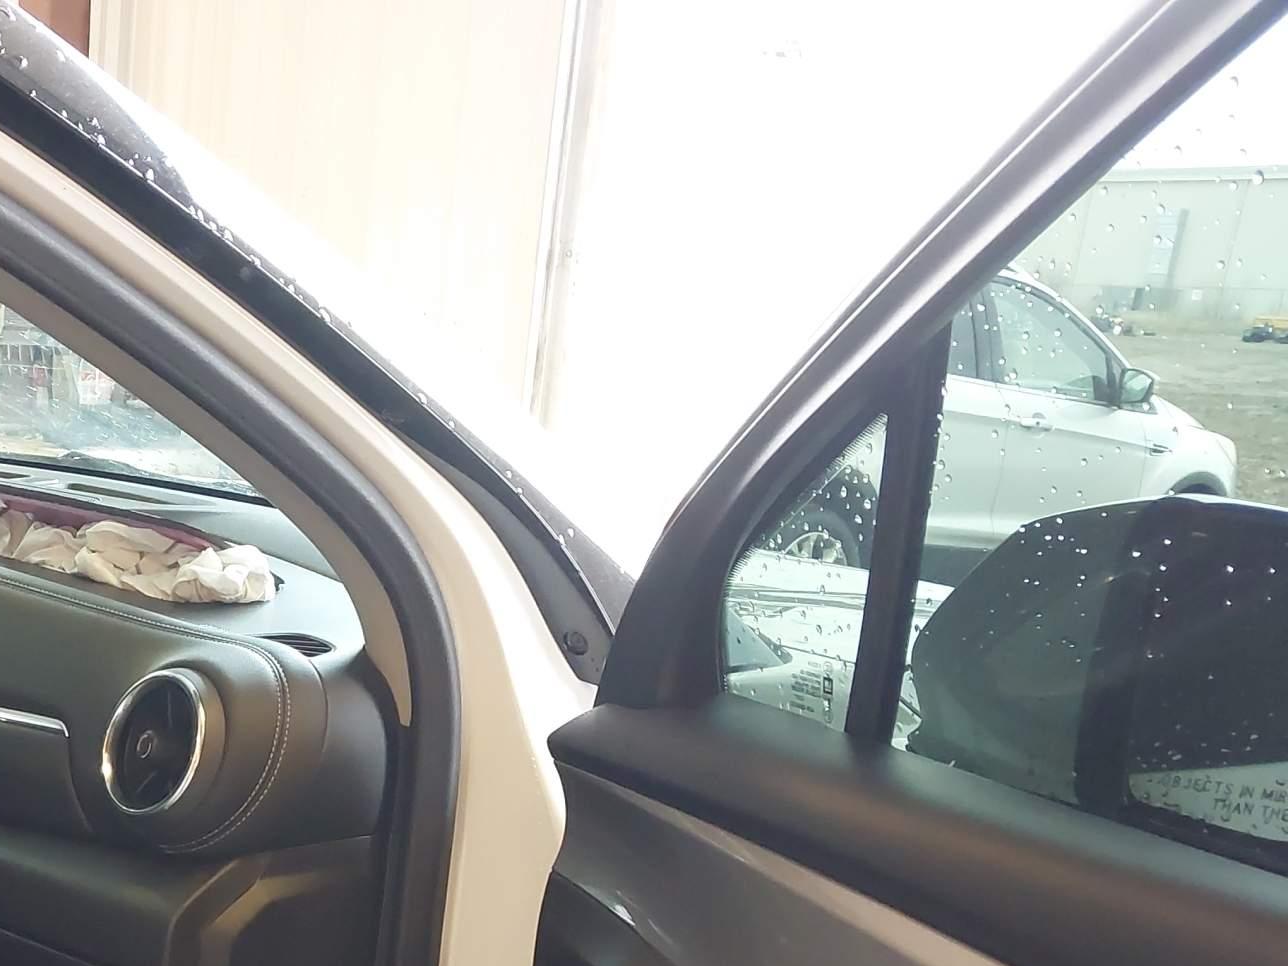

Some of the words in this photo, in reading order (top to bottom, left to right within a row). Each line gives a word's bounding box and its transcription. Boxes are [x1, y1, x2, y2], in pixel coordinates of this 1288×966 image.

[1161, 774, 1234, 795] OBJECTS
[1238, 786, 1255, 798] IN
[1213, 798, 1255, 815] THAN
